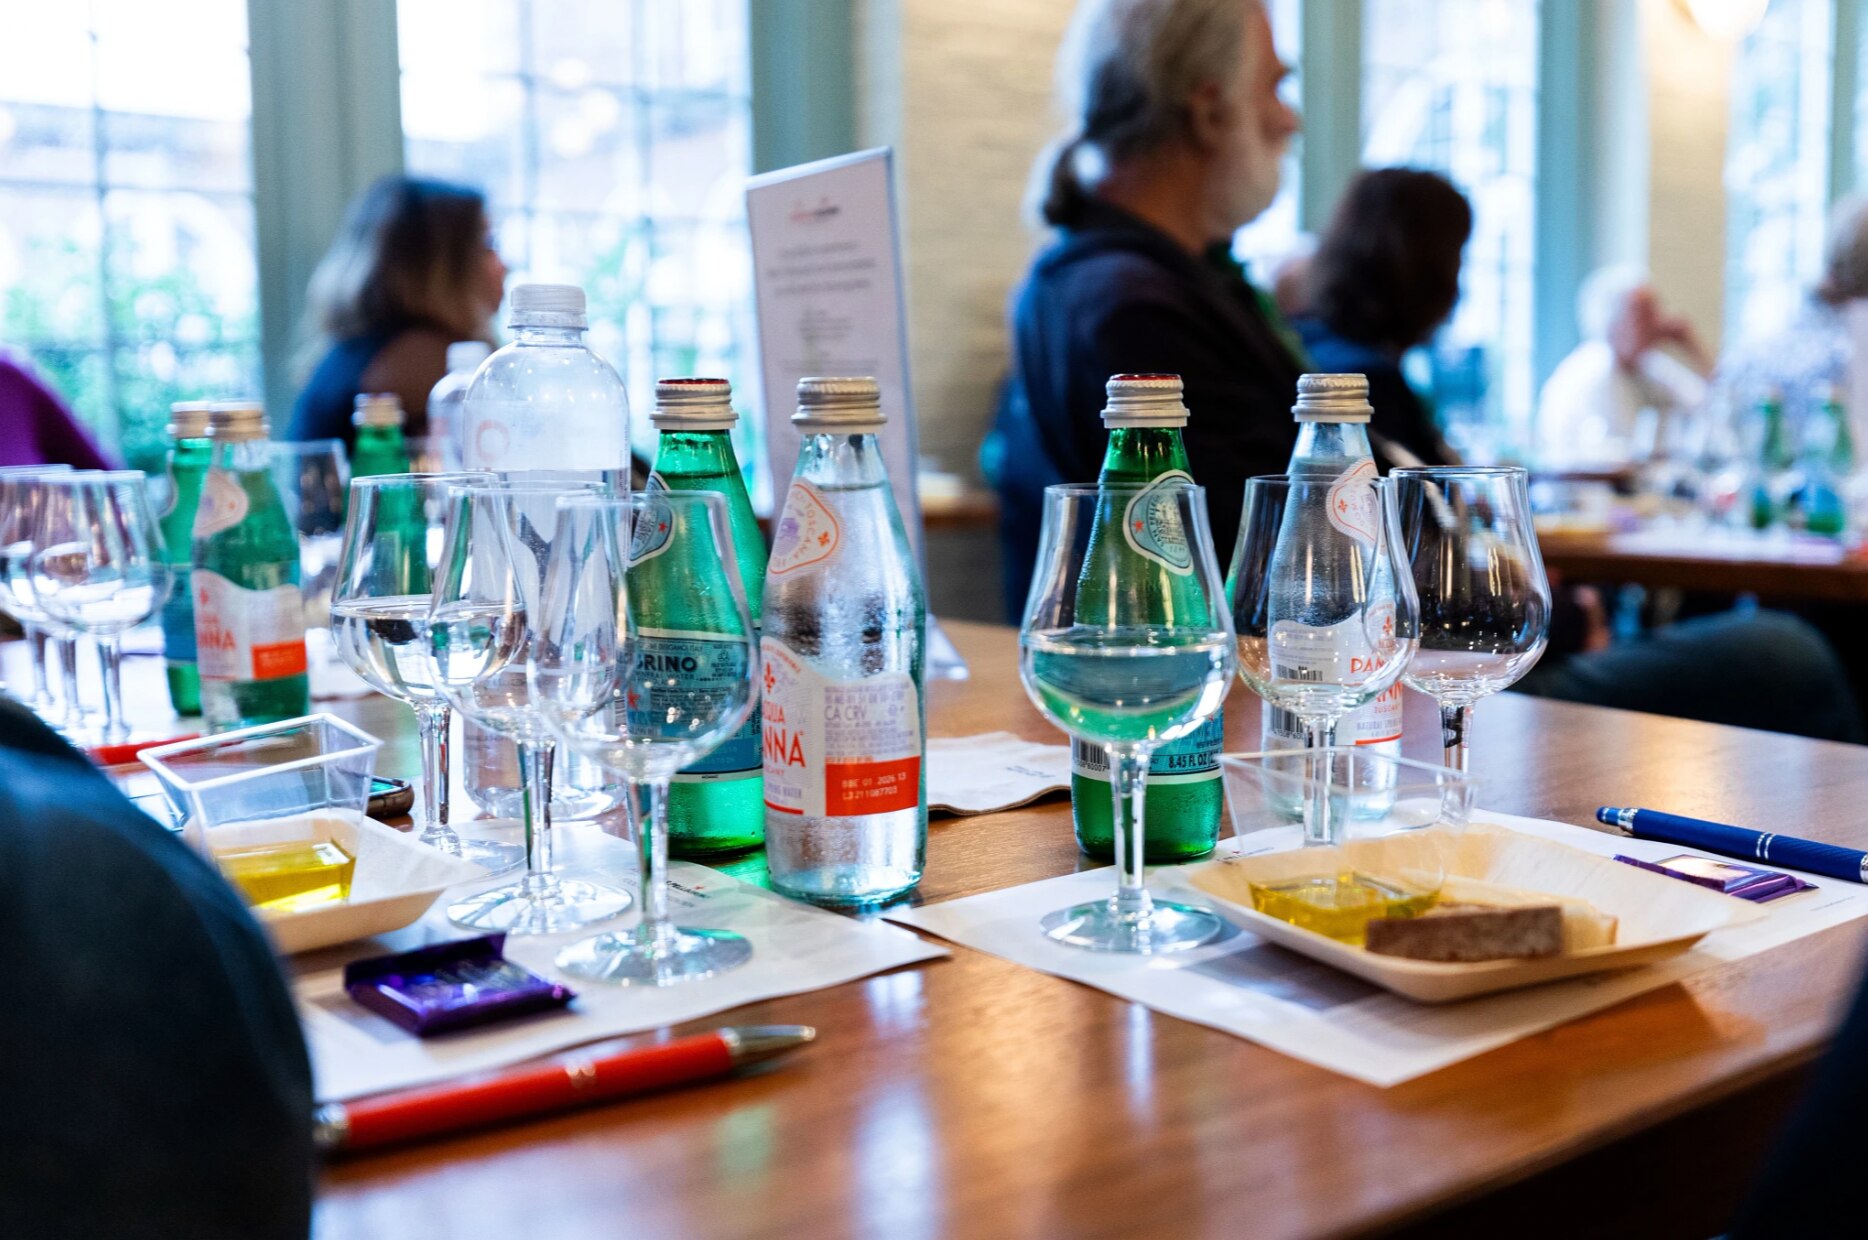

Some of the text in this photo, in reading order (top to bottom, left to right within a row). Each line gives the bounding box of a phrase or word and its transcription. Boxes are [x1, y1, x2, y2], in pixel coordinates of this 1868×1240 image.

[824, 705, 868, 721] CA CRV
[764, 726, 806, 767] NNA
[1169, 756, 1186, 769] 8.45
